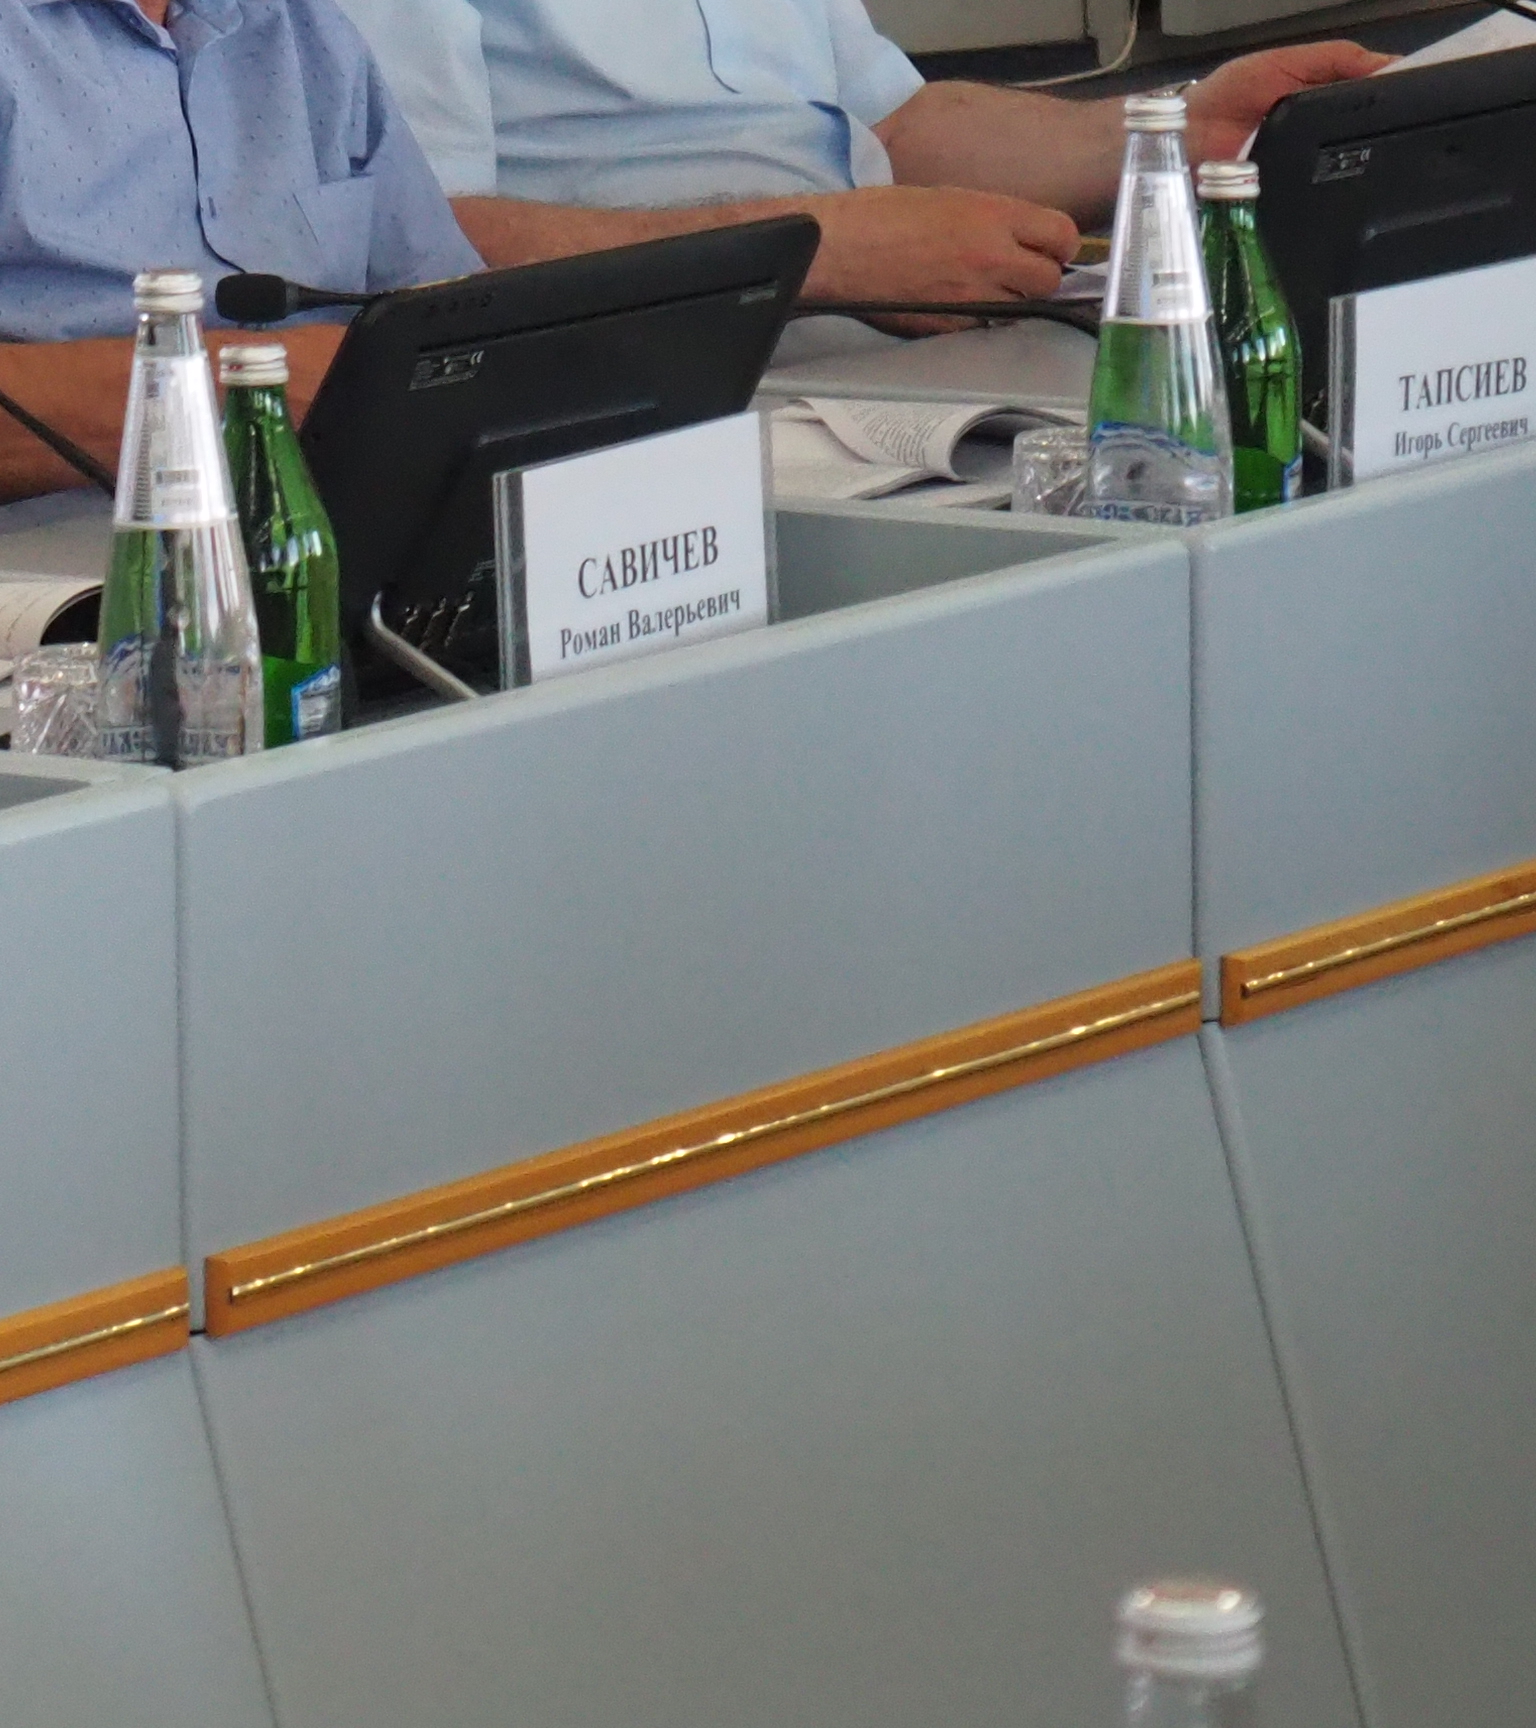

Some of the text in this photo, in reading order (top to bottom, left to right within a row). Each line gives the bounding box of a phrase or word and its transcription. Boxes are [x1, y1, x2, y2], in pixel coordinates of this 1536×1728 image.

[1399, 357, 1527, 411] ТАПСИЕВ
[1394, 417, 1528, 460] Игорь Сергеевич
[578, 526, 718, 599] САВИЧЕВ
[560, 589, 740, 659] Роман Валерьевич
